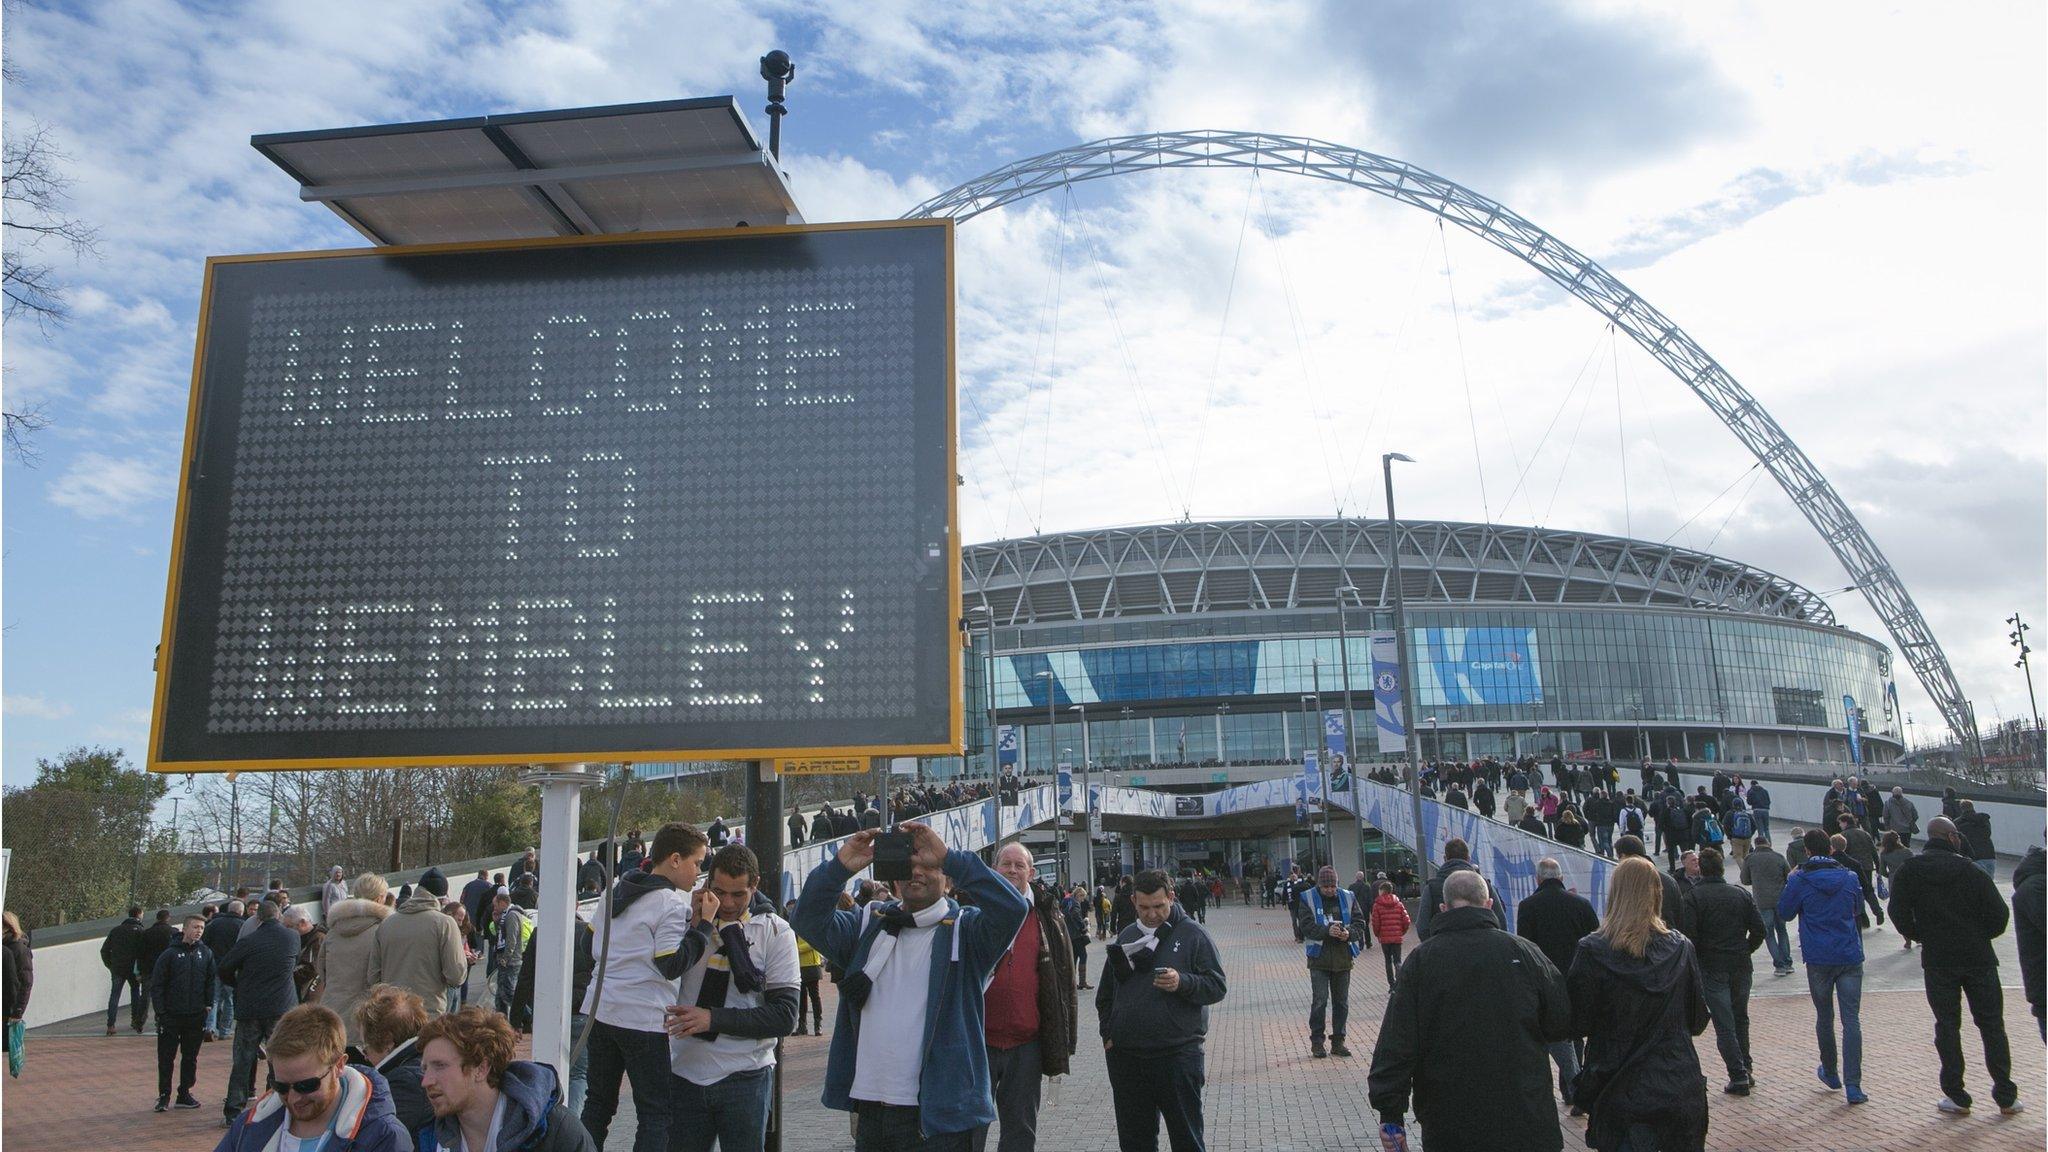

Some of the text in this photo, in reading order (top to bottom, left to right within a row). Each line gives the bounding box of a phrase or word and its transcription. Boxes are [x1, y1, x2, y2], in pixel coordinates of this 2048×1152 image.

[282, 303, 856, 427] WELCOME
[482, 452, 637, 560] TO
[252, 588, 856, 716] WEMBLEY
